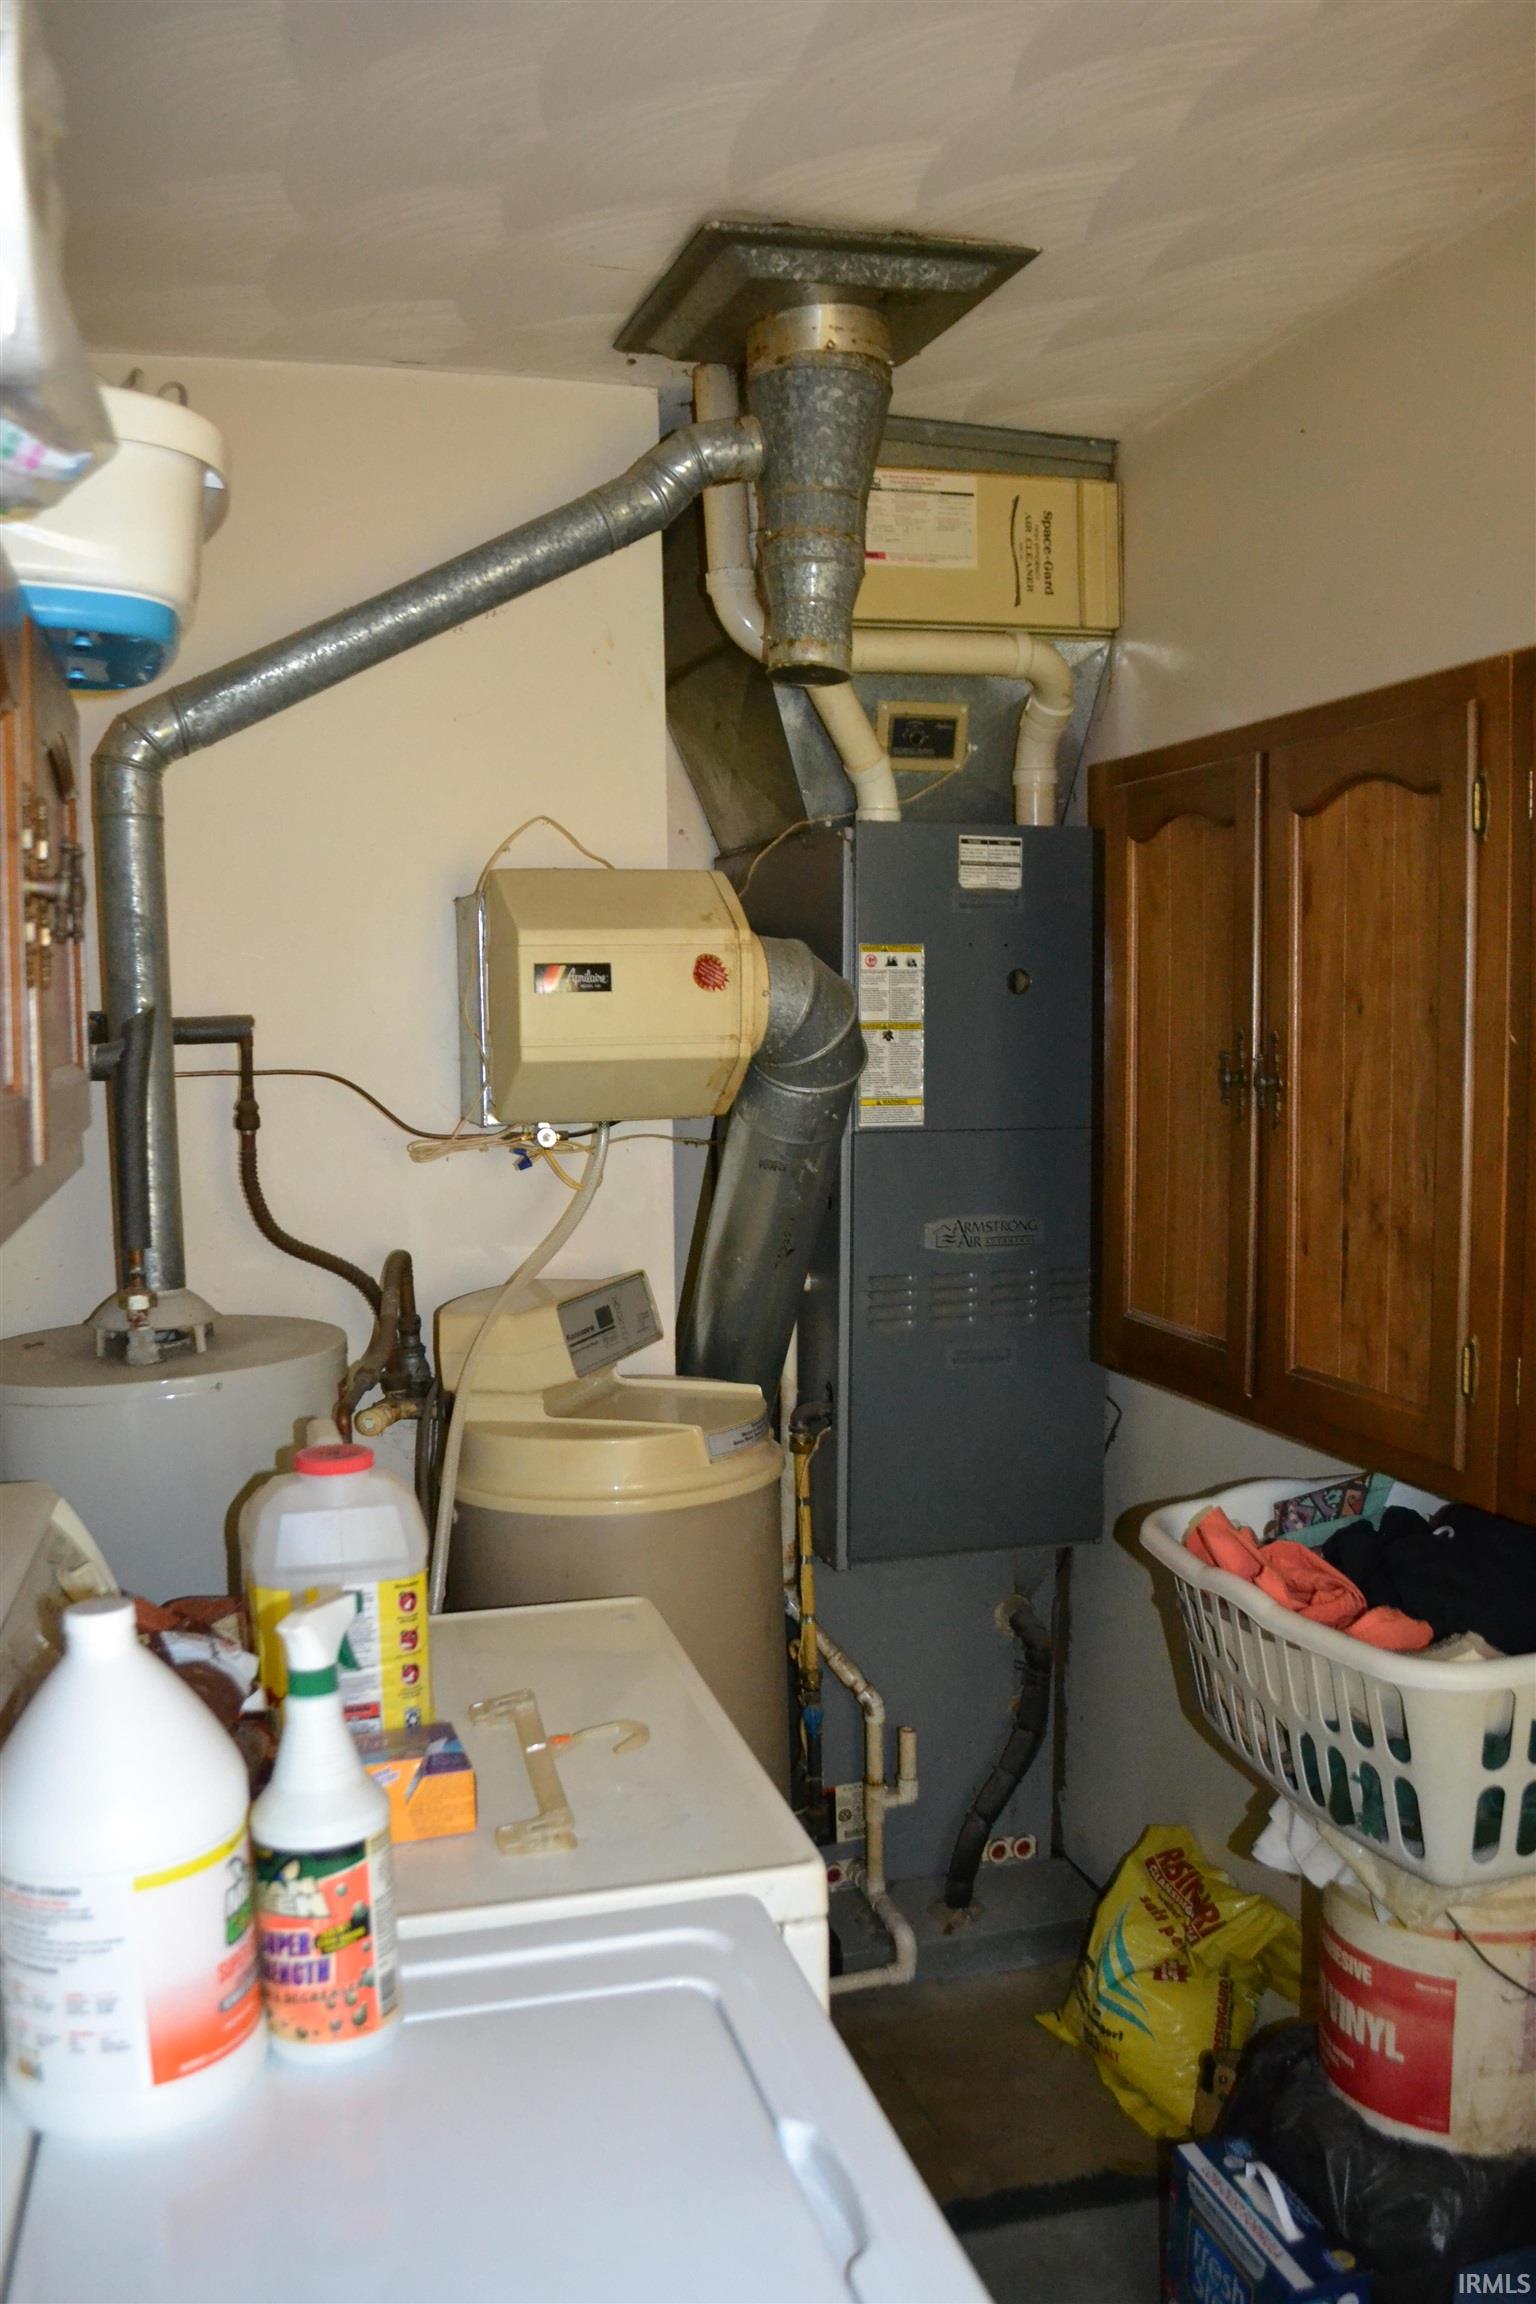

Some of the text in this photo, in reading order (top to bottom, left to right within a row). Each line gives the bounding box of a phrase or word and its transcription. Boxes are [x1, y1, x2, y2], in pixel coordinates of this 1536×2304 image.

[1025, 537, 1034, 593] CLEANER
[1042, 510, 1055, 596] Space-Gard
[952, 1218, 1038, 1235] ARMSTRONG
[958, 1234, 982, 1248] AIR
[1328, 1982, 1405, 2064] VINYL
[1192, 2228, 1245, 2304] Fresh
